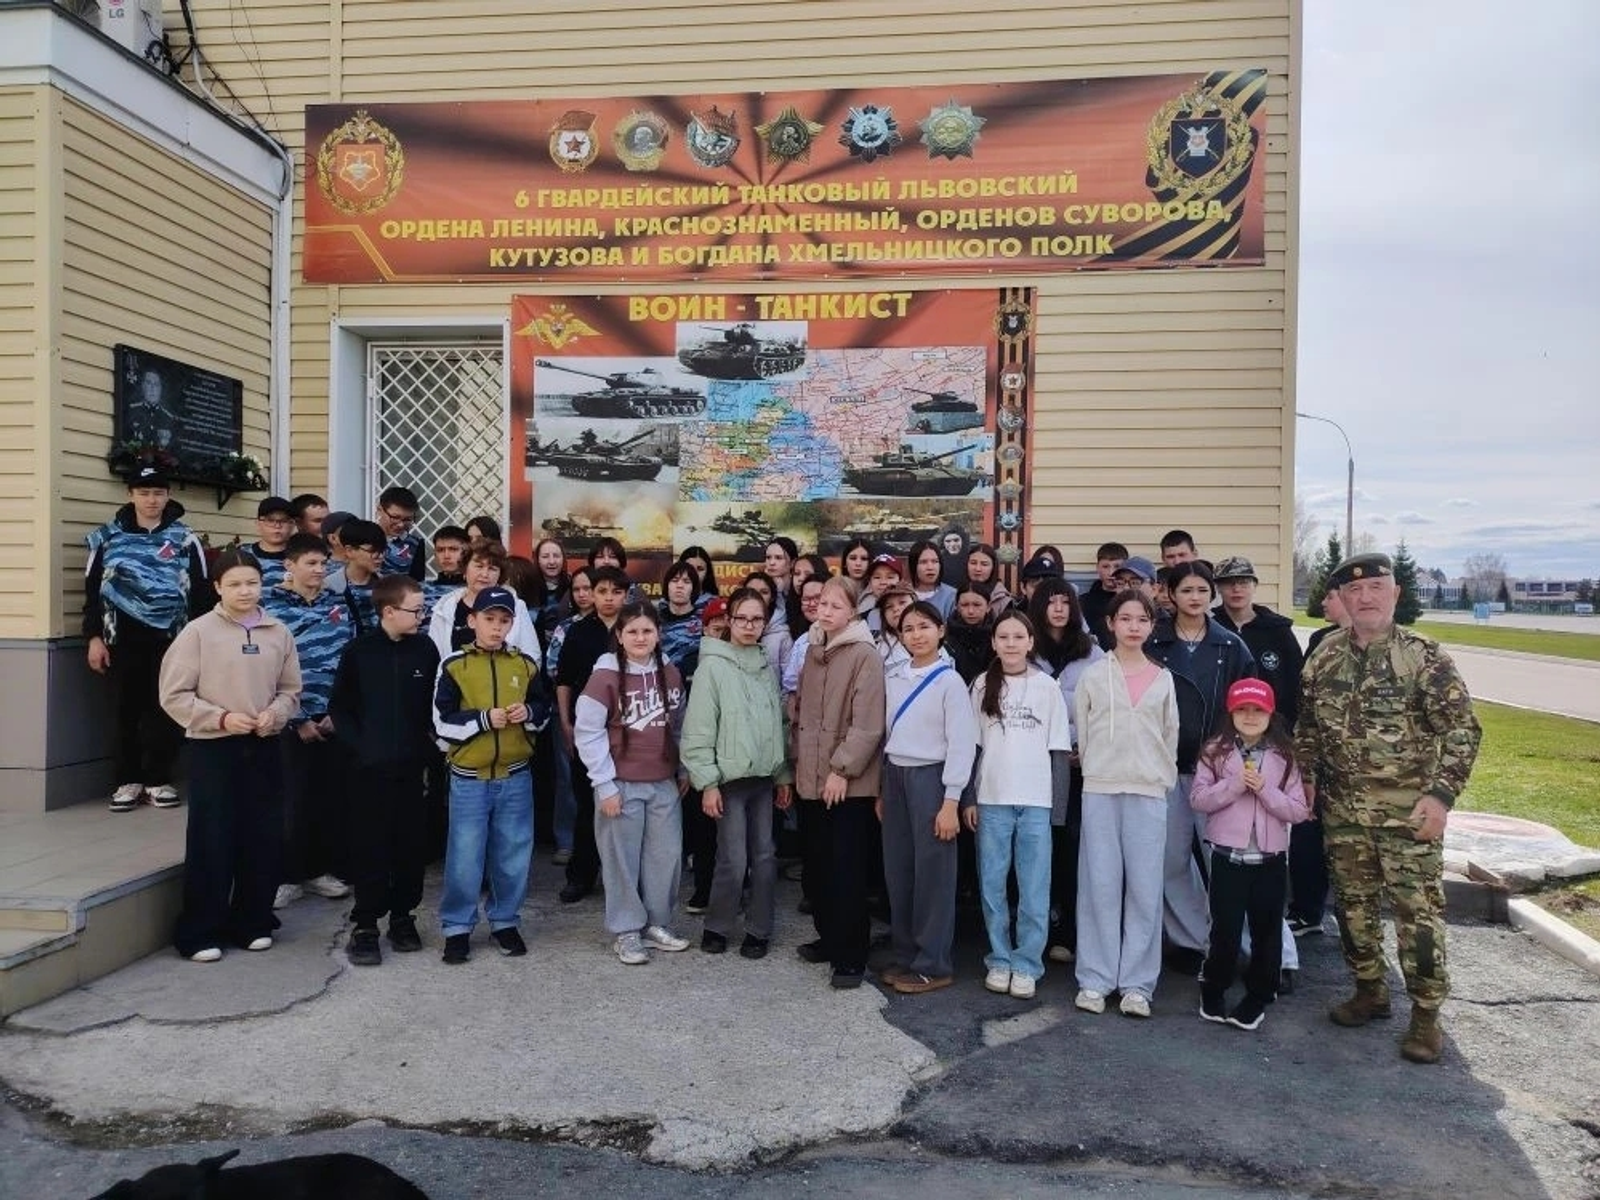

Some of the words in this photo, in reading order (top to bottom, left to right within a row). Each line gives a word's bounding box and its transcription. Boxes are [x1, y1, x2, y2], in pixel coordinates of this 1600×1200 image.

[108, 8, 125, 19] LG
[514, 189, 530, 208] 6
[537, 182, 729, 210] ГВАРДЕЙСКИЙ
[738, 176, 891, 205] ТАНКОВЫЙ
[897, 169, 1078, 200] ЛЬВОВСКИЙ
[380, 219, 485, 241] ОРДЕНА
[490, 218, 605, 240] ЛЕНИНА,
[614, 206, 908, 236] КРАСНОЗНАМЕННЫЙ,
[916, 206, 1056, 231] ОРДЕНОВ
[1063, 200, 1232, 225] СУВОРОВА,
[489, 247, 625, 268] КУТУЗОВА
[631, 247, 649, 265] И
[658, 244, 780, 267] БОГДАНА
[788, 236, 1022, 262] ХМЕЛЬНИЦКОГО
[1031, 234, 1114, 256] ПОЛК
[628, 296, 726, 322] ВОИН
[755, 292, 912, 321] ТАНКИСТ
